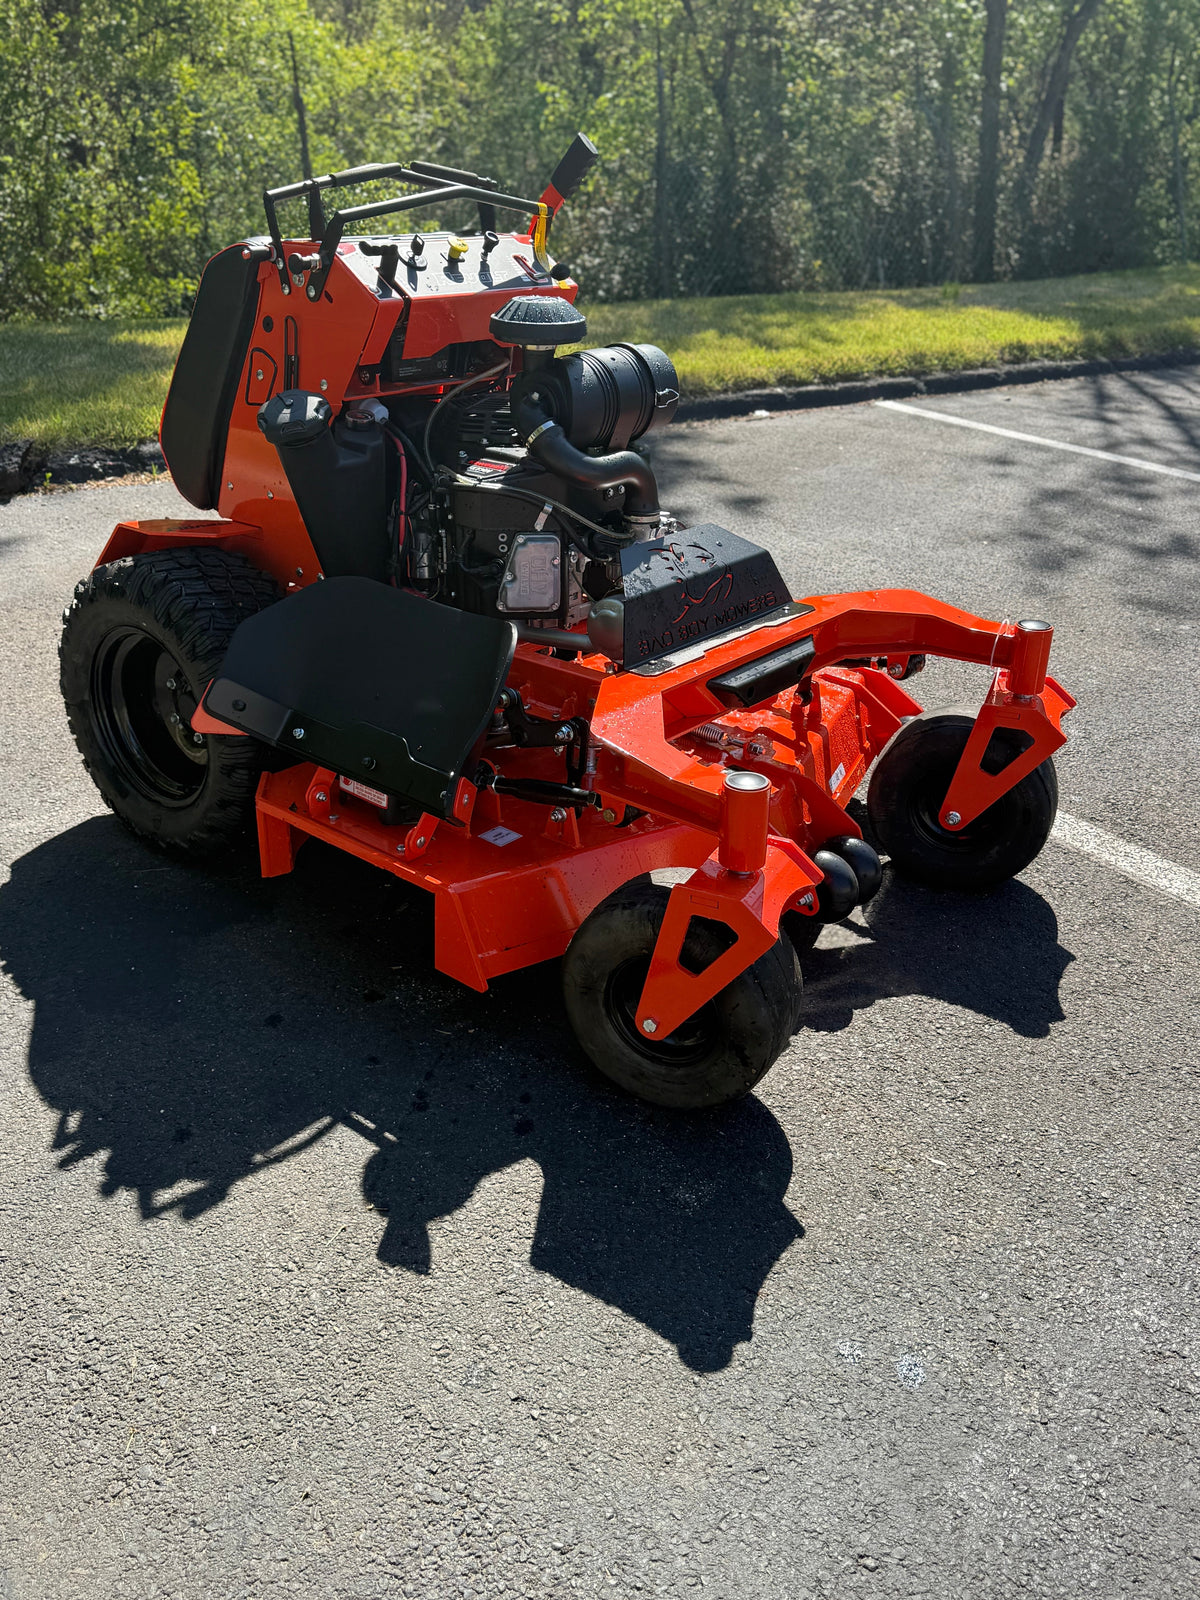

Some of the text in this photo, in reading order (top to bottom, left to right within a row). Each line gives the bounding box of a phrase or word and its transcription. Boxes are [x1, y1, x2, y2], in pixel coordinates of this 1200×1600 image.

[638, 592, 777, 656] BAD BOY MOWERS
